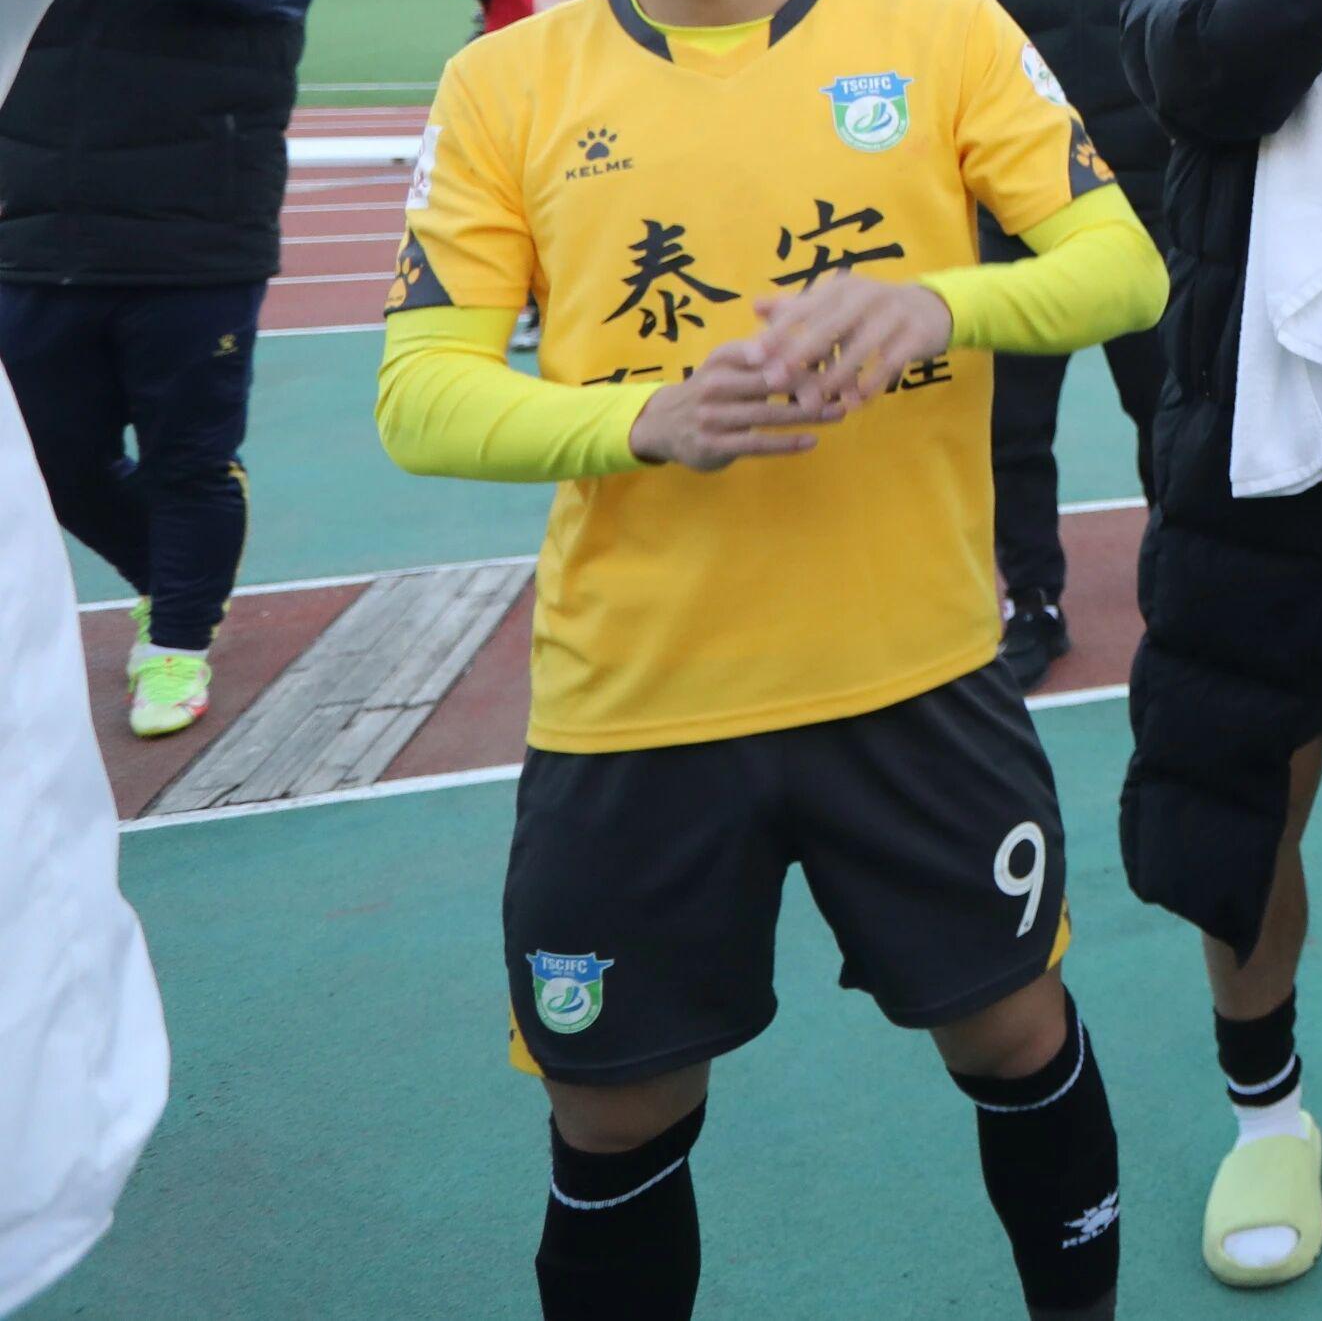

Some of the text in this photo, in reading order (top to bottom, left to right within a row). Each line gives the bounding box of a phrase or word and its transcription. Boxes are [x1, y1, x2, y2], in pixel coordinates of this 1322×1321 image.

[565, 157, 634, 182] KELME
[993, 820, 1047, 939] 9
[542, 956, 588, 975] TSCJFC
